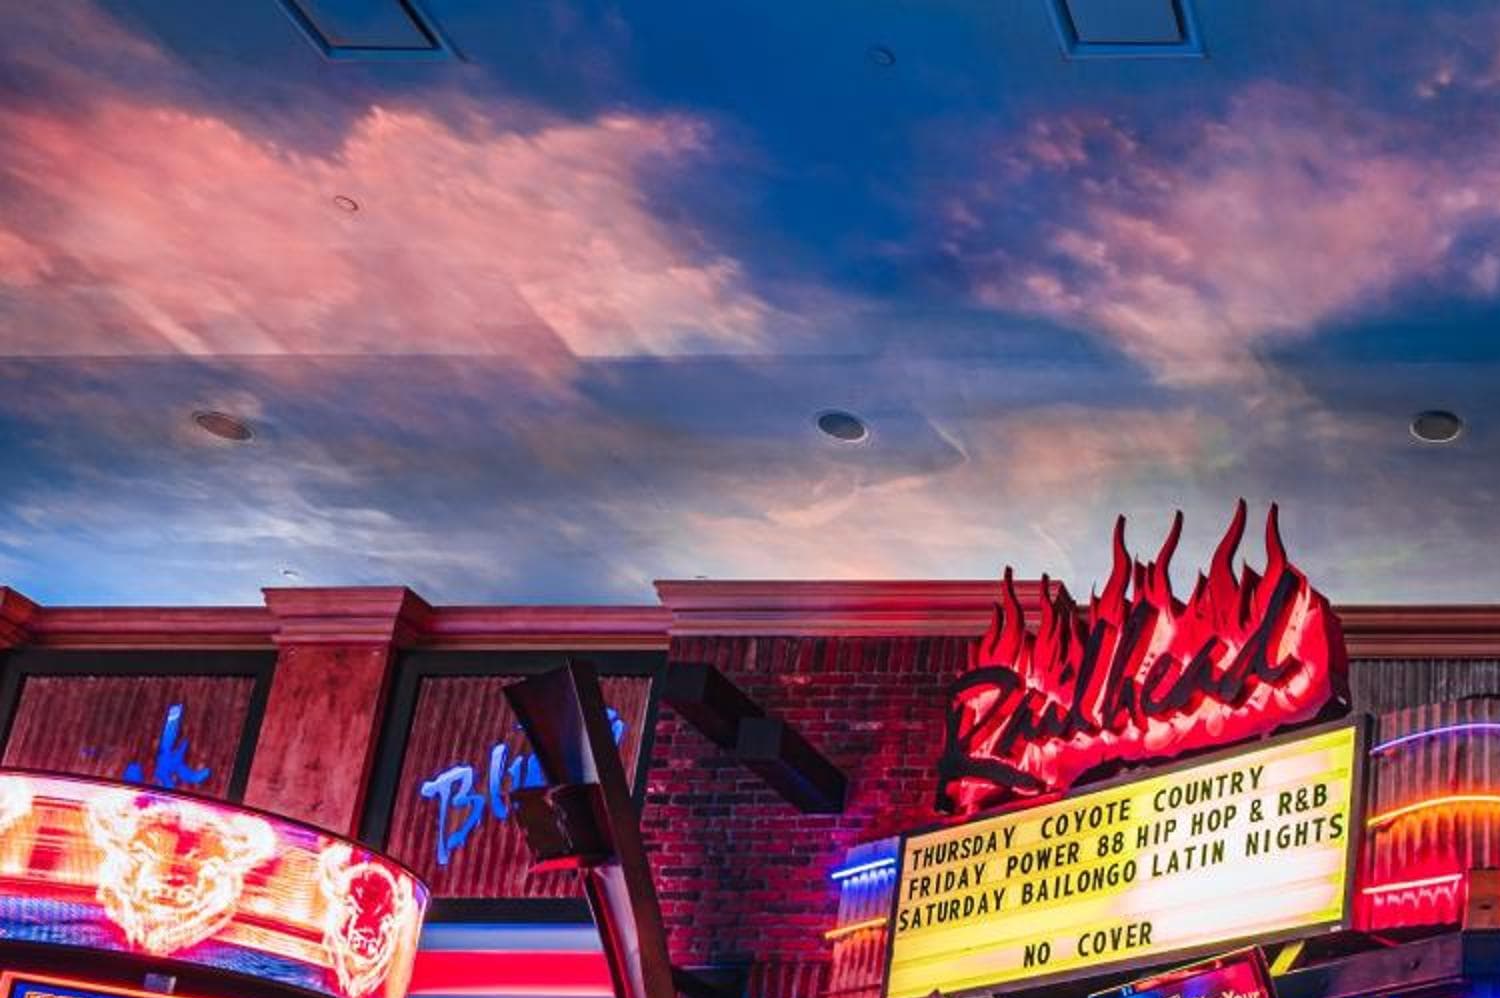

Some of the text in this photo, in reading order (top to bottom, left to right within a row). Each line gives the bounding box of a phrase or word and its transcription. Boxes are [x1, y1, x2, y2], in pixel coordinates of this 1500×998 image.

[936, 567, 1303, 815] Railhead
[898, 813, 1345, 932] SATURDAY BAILONGO LATIN NIGHTS
[908, 782, 1329, 901] FRIDAY POWER 88 HIP HOP & R&B
[911, 764, 1266, 871] THURSDAY COYOTE COUNTRY
[1022, 922, 1153, 969] NO COVER
